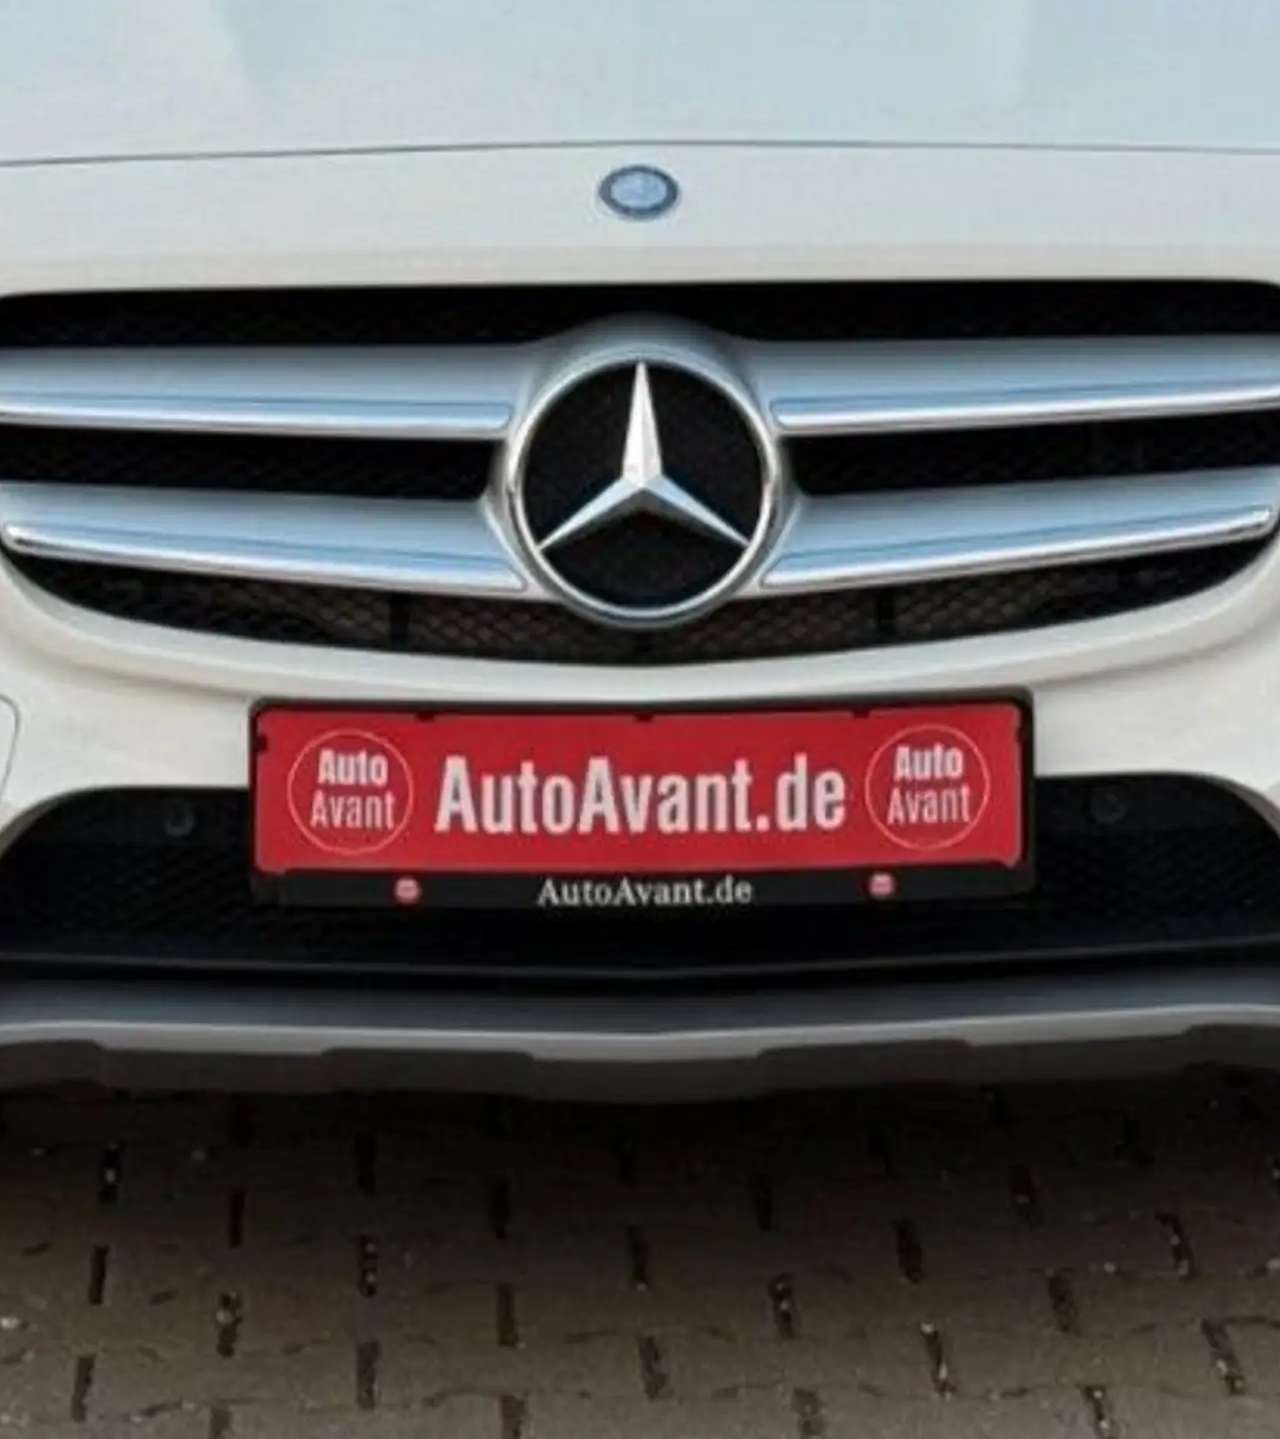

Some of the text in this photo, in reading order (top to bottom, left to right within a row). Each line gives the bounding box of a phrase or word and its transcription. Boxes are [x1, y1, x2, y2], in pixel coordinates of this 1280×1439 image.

[317, 748, 389, 788] Auto
[893, 742, 964, 782] Auto
[308, 788, 396, 831] Avant
[433, 751, 846, 836] AutoAvant.de
[887, 783, 972, 826] Avant
[537, 873, 754, 908] AutoAvant.de
